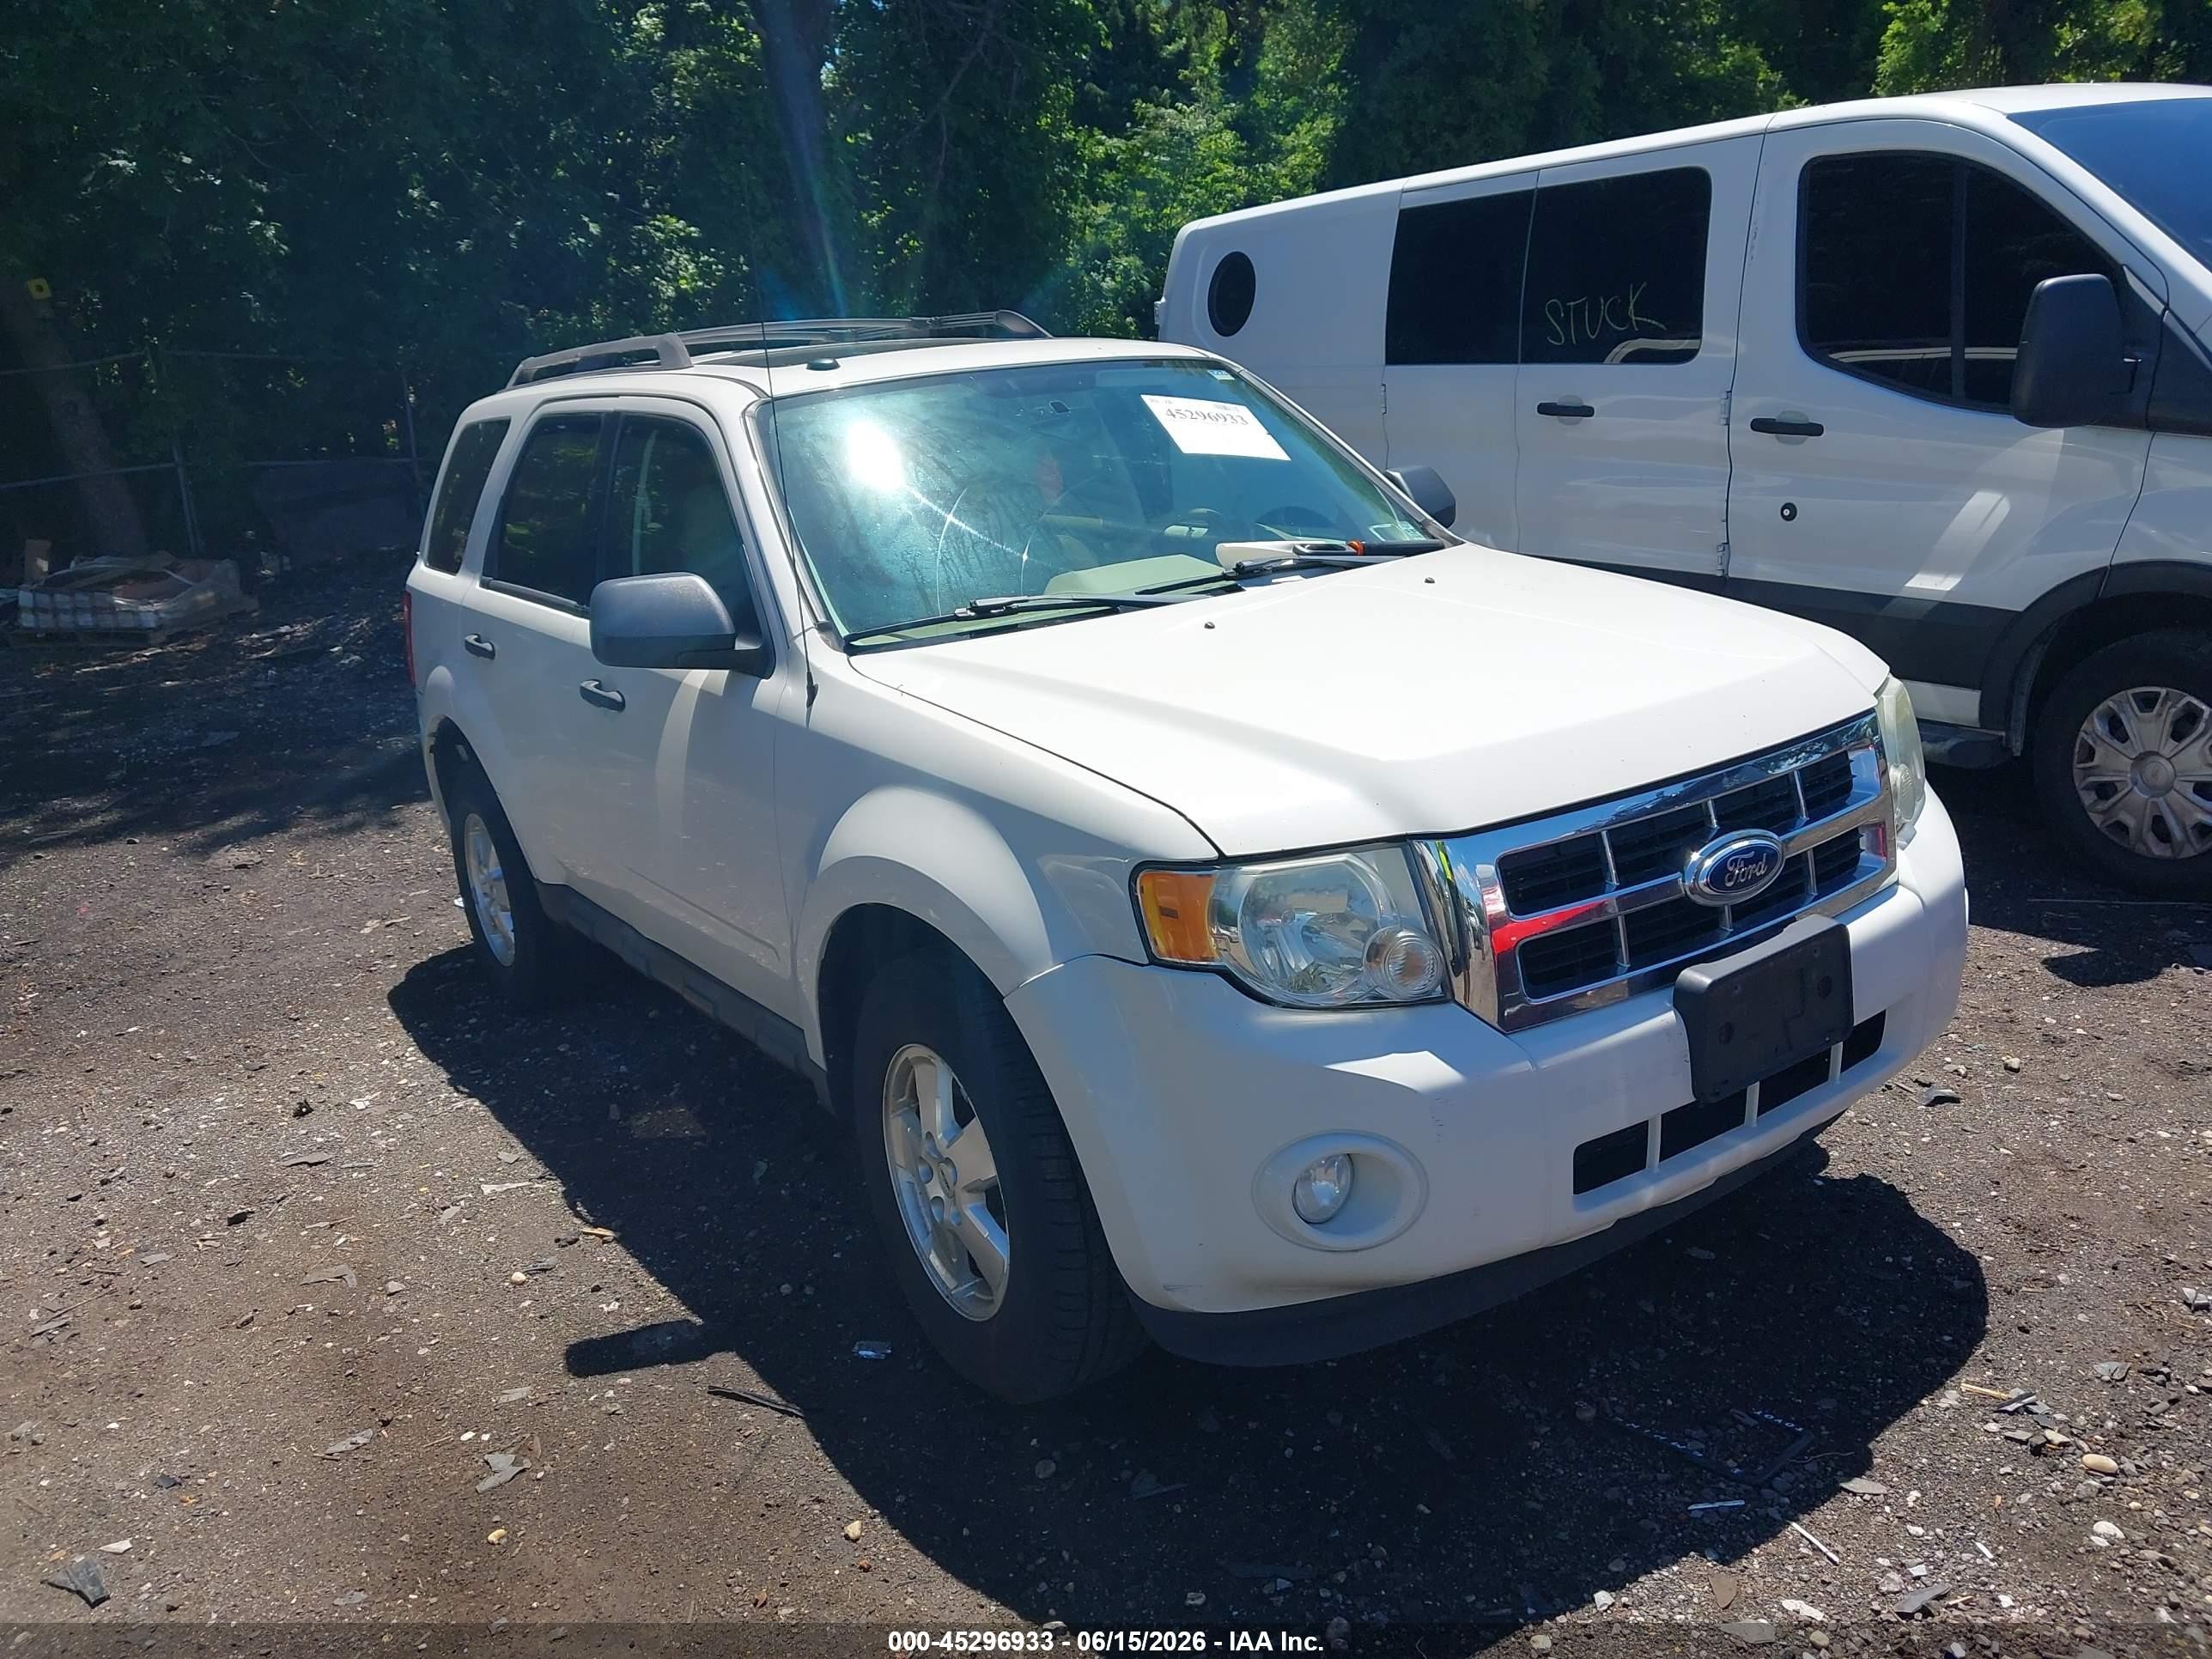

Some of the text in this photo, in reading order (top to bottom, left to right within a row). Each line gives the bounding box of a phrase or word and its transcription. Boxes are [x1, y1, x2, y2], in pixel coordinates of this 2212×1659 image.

[1546, 282, 1668, 346] STUCK
[1165, 408, 1249, 426] 45296933
[1724, 851, 1768, 887] Ford
